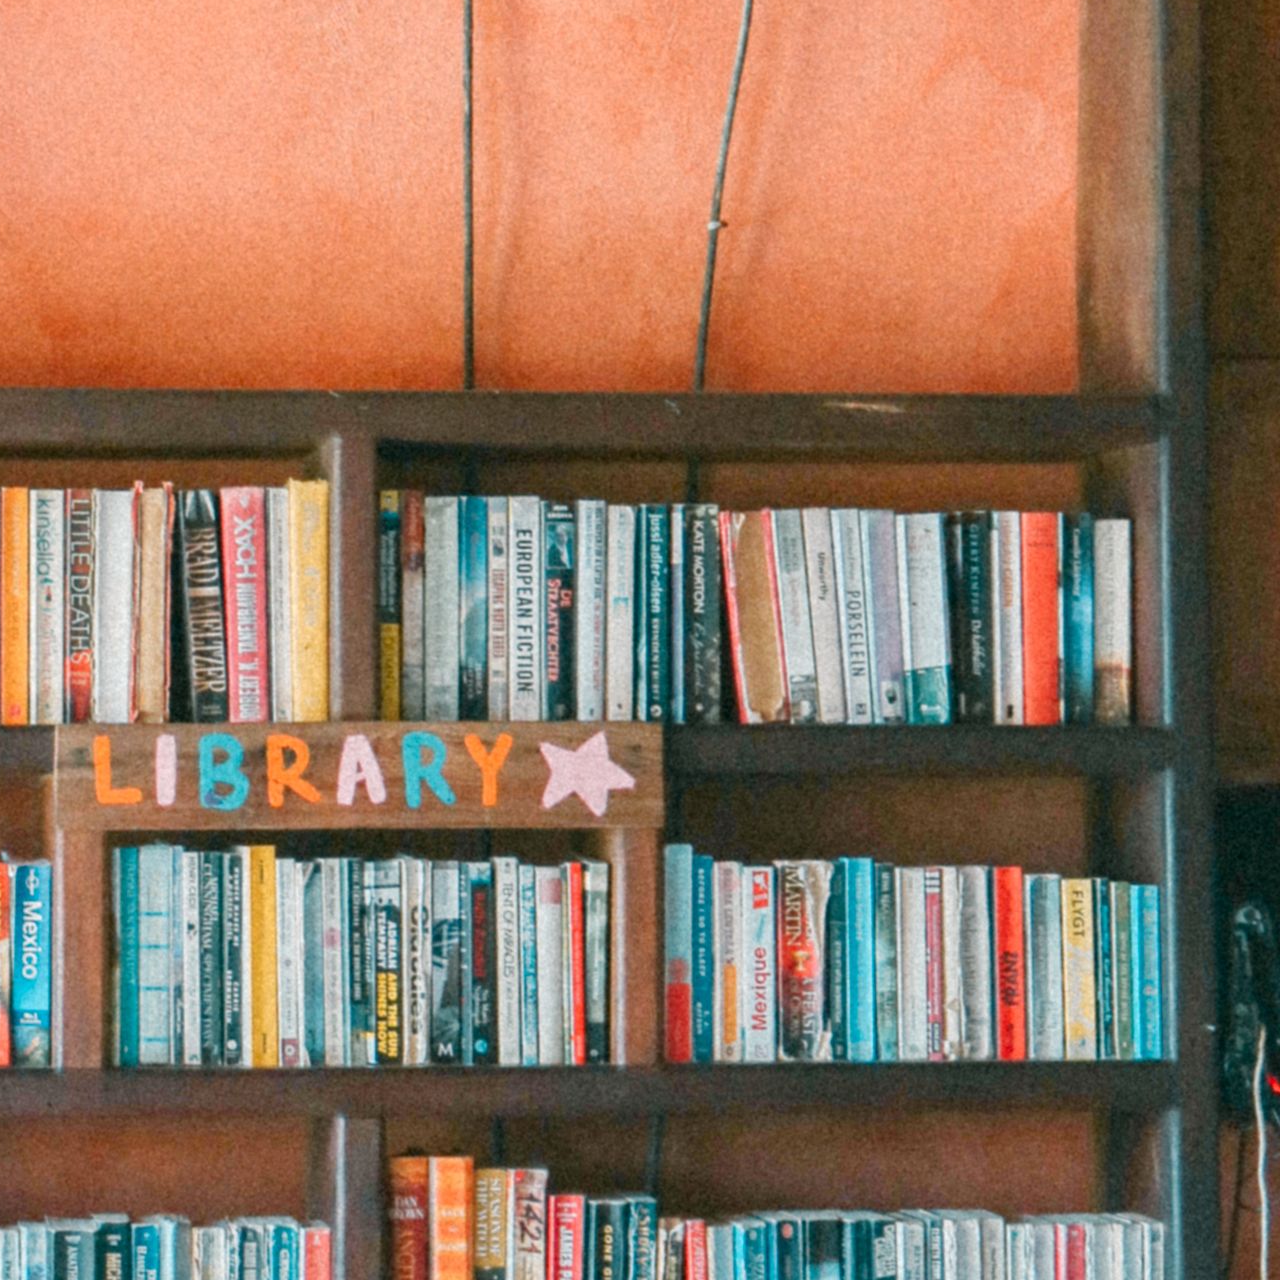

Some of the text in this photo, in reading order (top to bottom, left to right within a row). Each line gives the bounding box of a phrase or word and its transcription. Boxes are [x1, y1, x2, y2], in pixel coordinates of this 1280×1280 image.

[37, 497, 54, 577] kinsella
[233, 514, 258, 578] HOAX
[693, 520, 705, 554] KATE
[70, 498, 91, 665] LITTLE DEATHS
[560, 589, 573, 607] DE
[651, 544, 663, 613] adler-olsen
[693, 556, 705, 614] MORTON
[817, 551, 828, 601] Unworthy
[184, 526, 227, 693] BRAD MELTZER
[515, 528, 535, 693] EUROPEAN FICTION
[847, 590, 866, 677] PORSELEIN
[93, 731, 513, 811] LIBRARY
[697, 868, 706, 906] BEFORE
[784, 867, 806, 947] MARTIN
[1072, 889, 1086, 938] FLYGT
[22, 900, 42, 979] Mexico
[377, 910, 387, 968] TEMPANY
[387, 920, 398, 969] ADRIAN
[503, 881, 515, 979] TENT OF MIRACLES
[697, 915, 706, 929] GO
[698, 931, 707, 944] TO
[698, 947, 707, 977] SLEEP
[750, 947, 771, 1031] Mexique
[377, 971, 388, 1054] SHINES NOW
[387, 971, 399, 1058] AND THE SUN
[802, 991, 817, 1036] FEAST
[477, 1178, 488, 1258] THE WITCH
[489, 1177, 502, 1258] SEASON OF
[517, 1190, 543, 1255] 1421
[558, 1226, 574, 1267] JAMES
[603, 1224, 614, 1263] GONE
